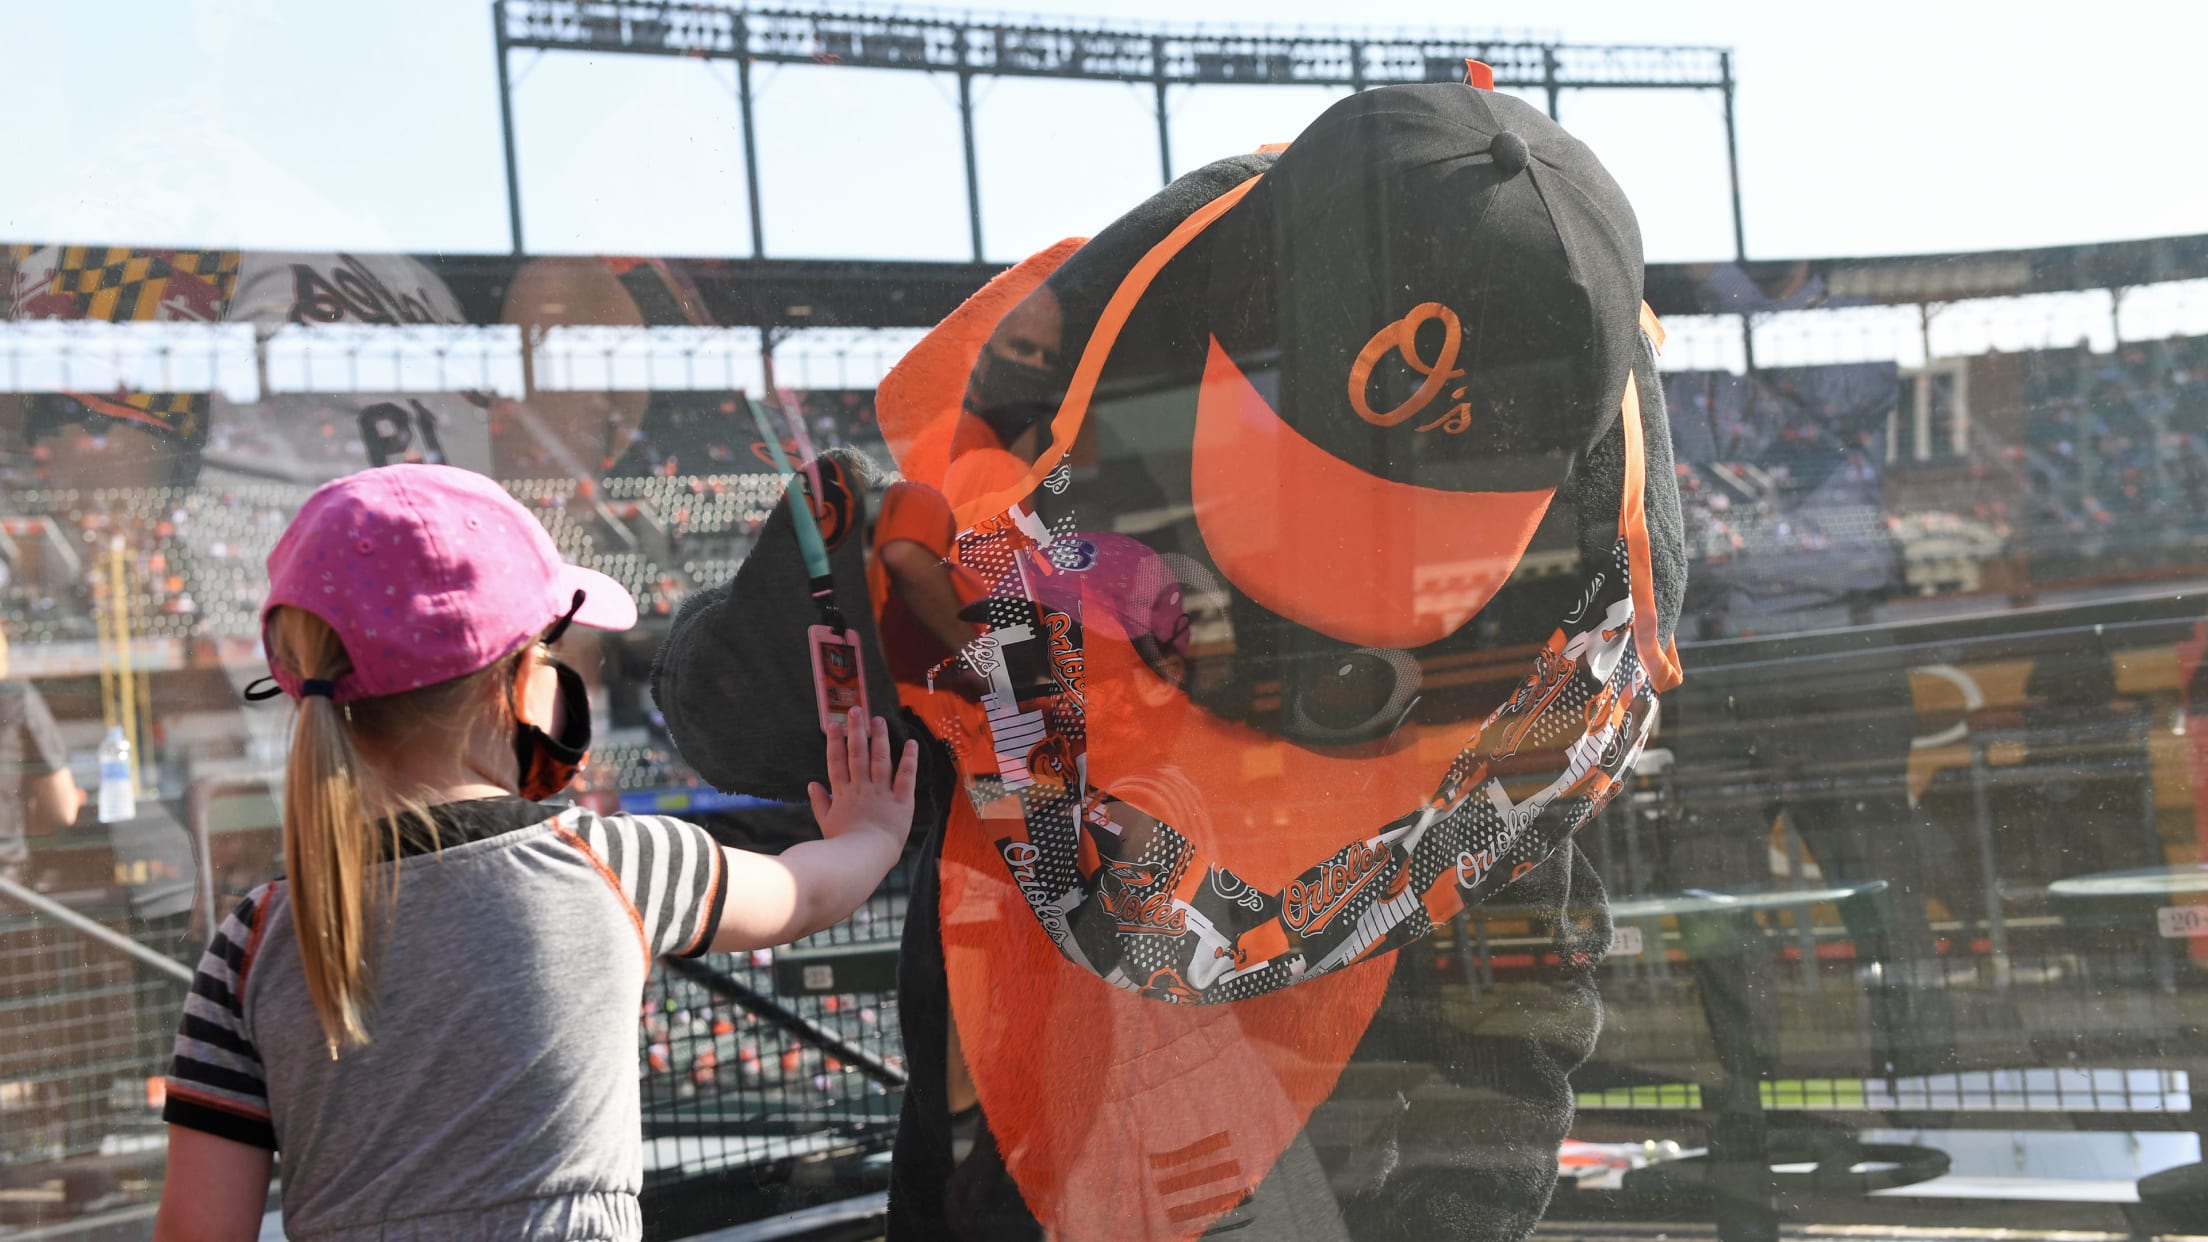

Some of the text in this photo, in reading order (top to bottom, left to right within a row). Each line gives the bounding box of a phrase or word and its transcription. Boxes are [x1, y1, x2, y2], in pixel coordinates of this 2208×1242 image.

[1347, 301, 1473, 435] O's
[1003, 841, 1069, 949] Orioles
[1282, 840, 1392, 938] Orioles
[1456, 802, 1546, 889] Orioles
